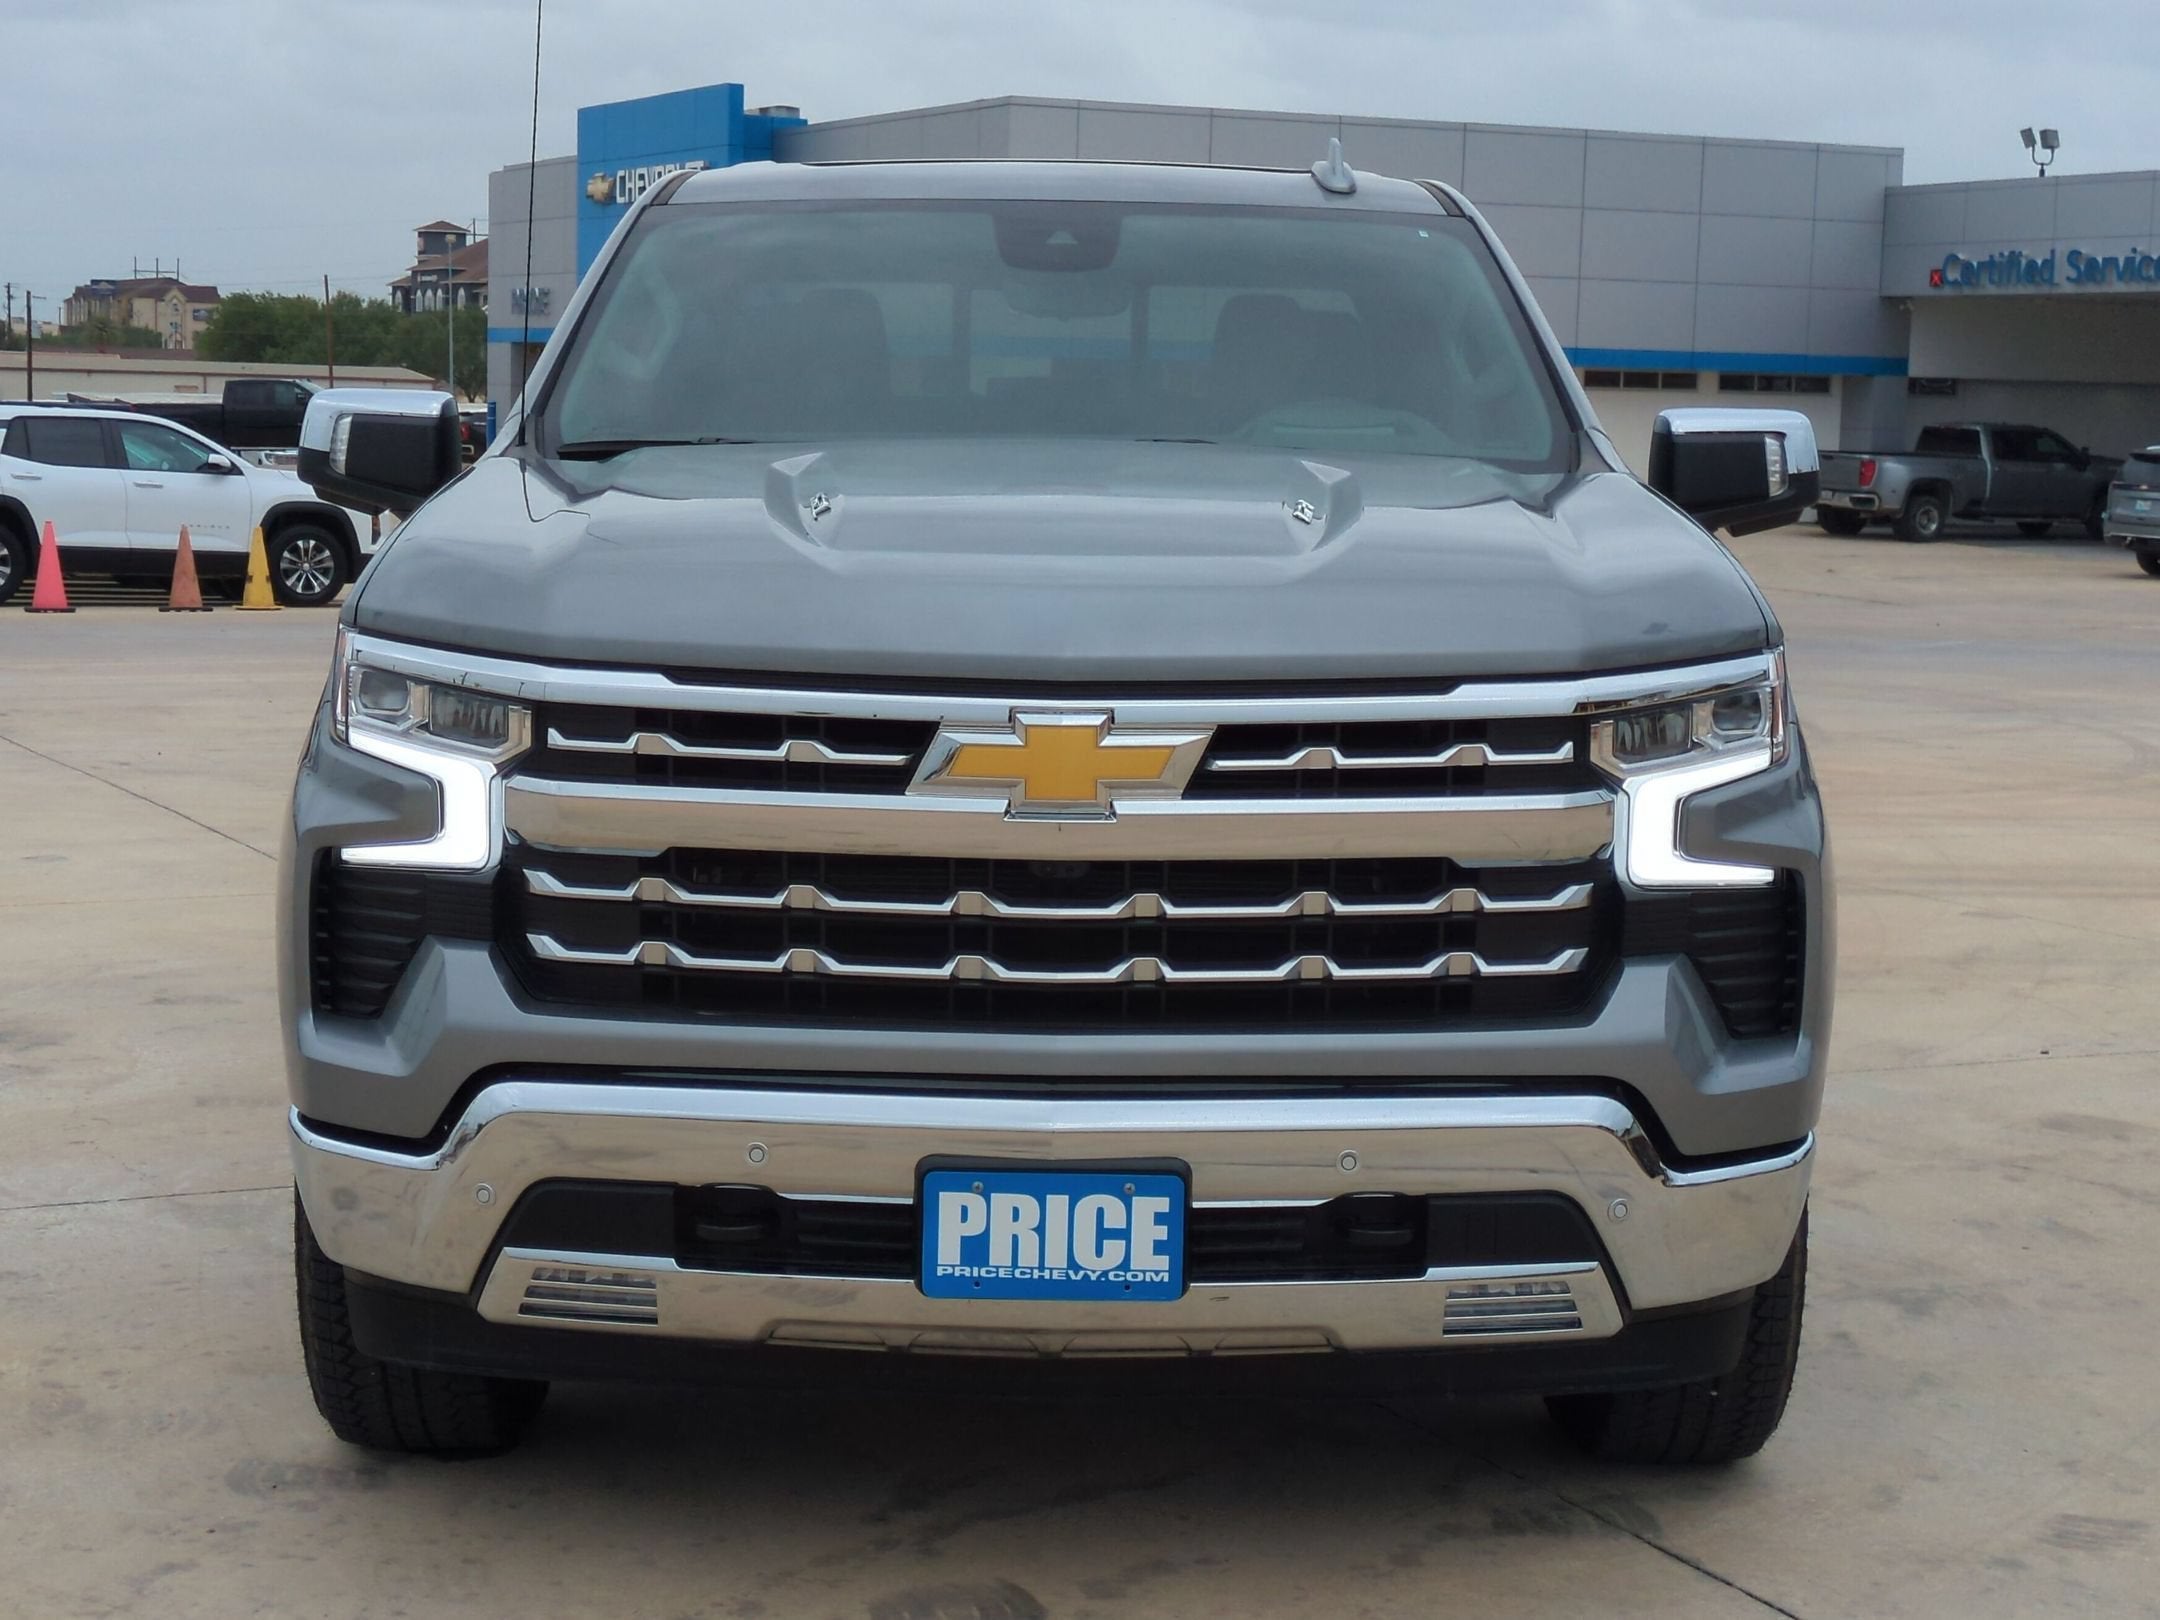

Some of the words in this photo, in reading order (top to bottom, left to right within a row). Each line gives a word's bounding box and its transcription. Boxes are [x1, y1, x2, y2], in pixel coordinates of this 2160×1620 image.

[616, 160, 705, 204] CHEVR
[1942, 248, 2058, 287] Certified
[937, 1191, 1170, 1271] PRICE
[936, 1265, 1169, 1282] PRICECHEVY.COM
